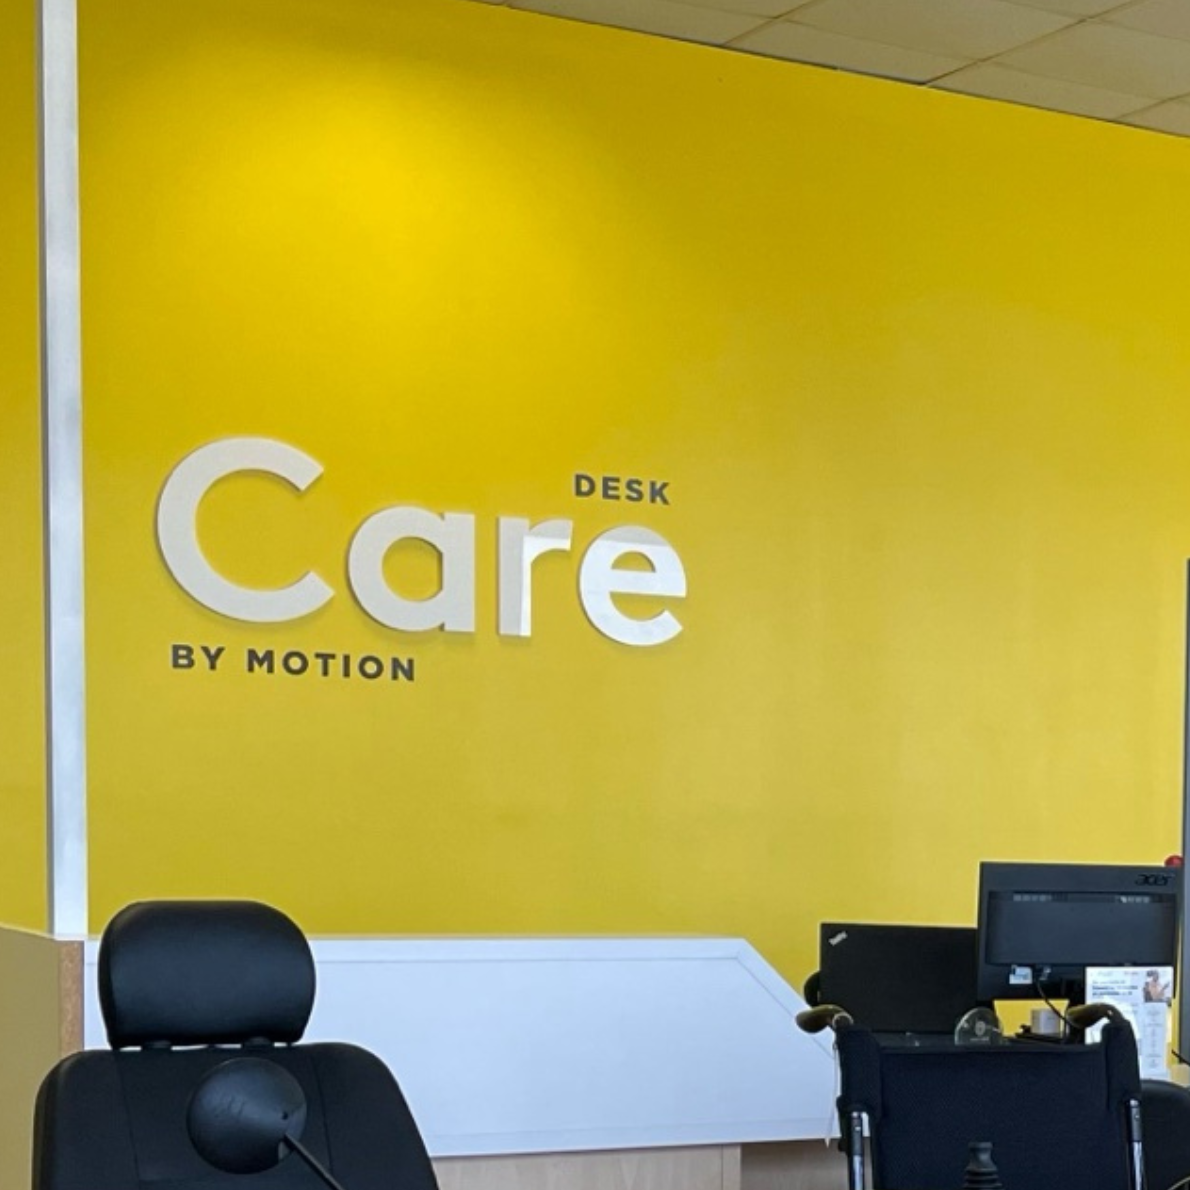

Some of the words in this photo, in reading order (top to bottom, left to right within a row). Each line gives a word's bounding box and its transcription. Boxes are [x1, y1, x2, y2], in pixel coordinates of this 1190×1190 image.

[574, 473, 671, 506] DESK
[156, 436, 688, 646] Care
[171, 644, 225, 671] BY
[247, 648, 415, 682] MOTION
[1134, 874, 1174, 887] acer
